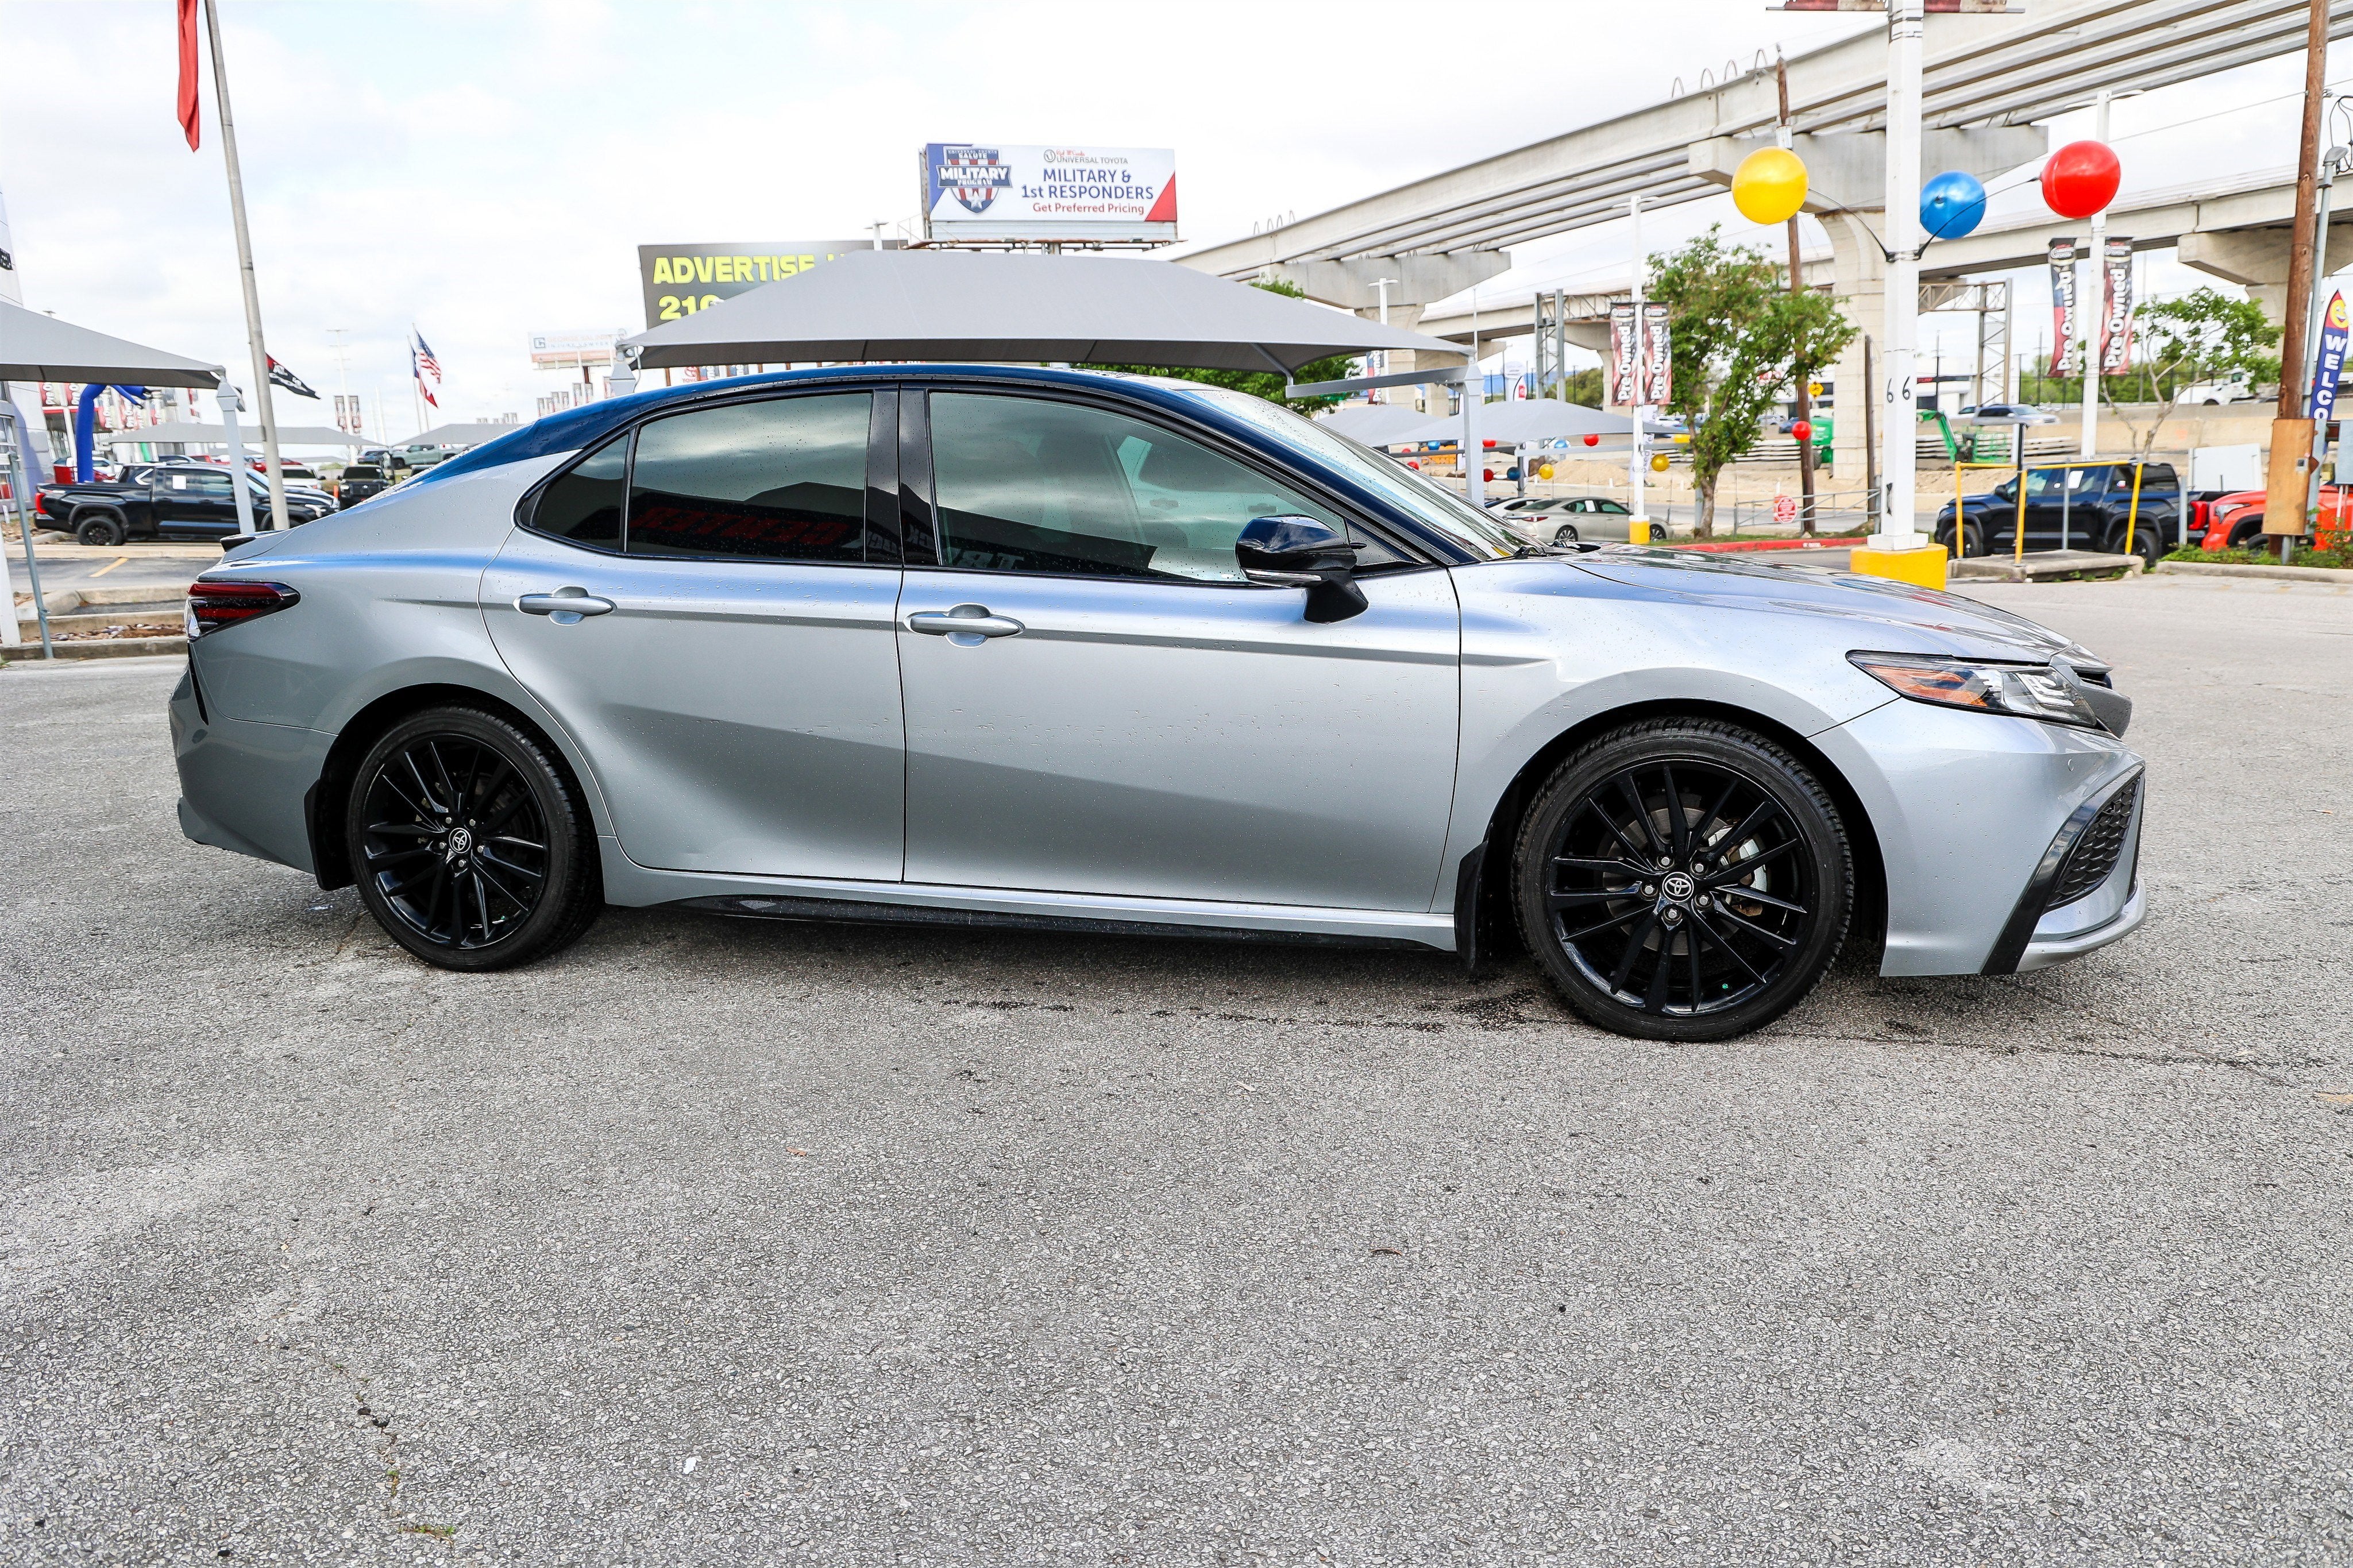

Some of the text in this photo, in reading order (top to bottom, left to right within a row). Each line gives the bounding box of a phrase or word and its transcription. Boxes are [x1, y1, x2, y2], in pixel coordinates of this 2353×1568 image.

[940, 167, 1008, 180] MILITARY
[1043, 168, 1131, 183] MILITARY &
[1021, 184, 1154, 199] 1st RESPONDERS
[1033, 203, 1144, 215] Get Preferred Pricing
[2108, 268, 2127, 333] Owned
[1617, 325, 1631, 375] Owned
[1649, 325, 1664, 375] Owned
[2104, 335, 2123, 368] Pre
[1618, 376, 1631, 400] Pre
[1650, 375, 1664, 400] Pre
